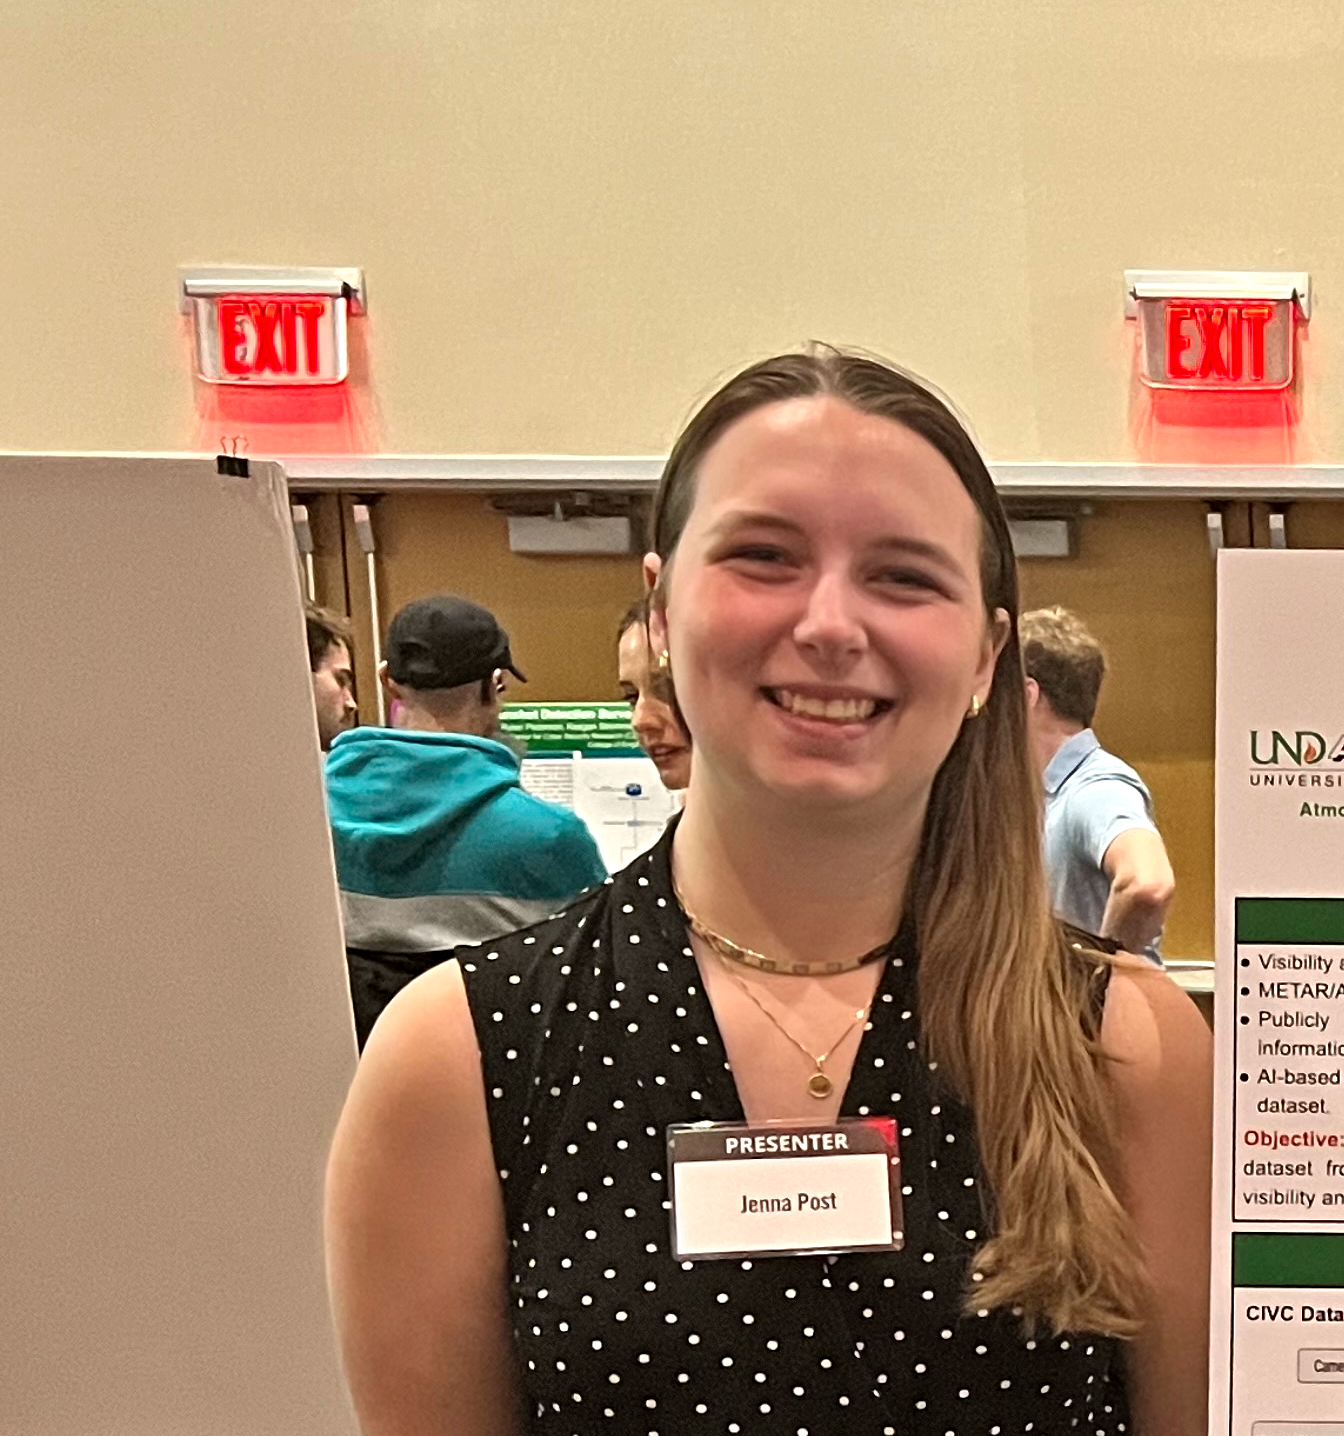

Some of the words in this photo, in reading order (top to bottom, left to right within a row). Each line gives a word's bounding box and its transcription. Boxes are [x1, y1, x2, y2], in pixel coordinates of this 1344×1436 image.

[220, 301, 324, 374] EXIT
[1166, 306, 1271, 381] EXIT
[1250, 731, 1326, 766] UND
[1258, 954, 1333, 974] Visibility
[725, 1133, 849, 1154] PRESENTER
[741, 1195, 791, 1214] Jenna
[797, 1192, 837, 1211] Post
[1247, 1306, 1293, 1321] CIVC
